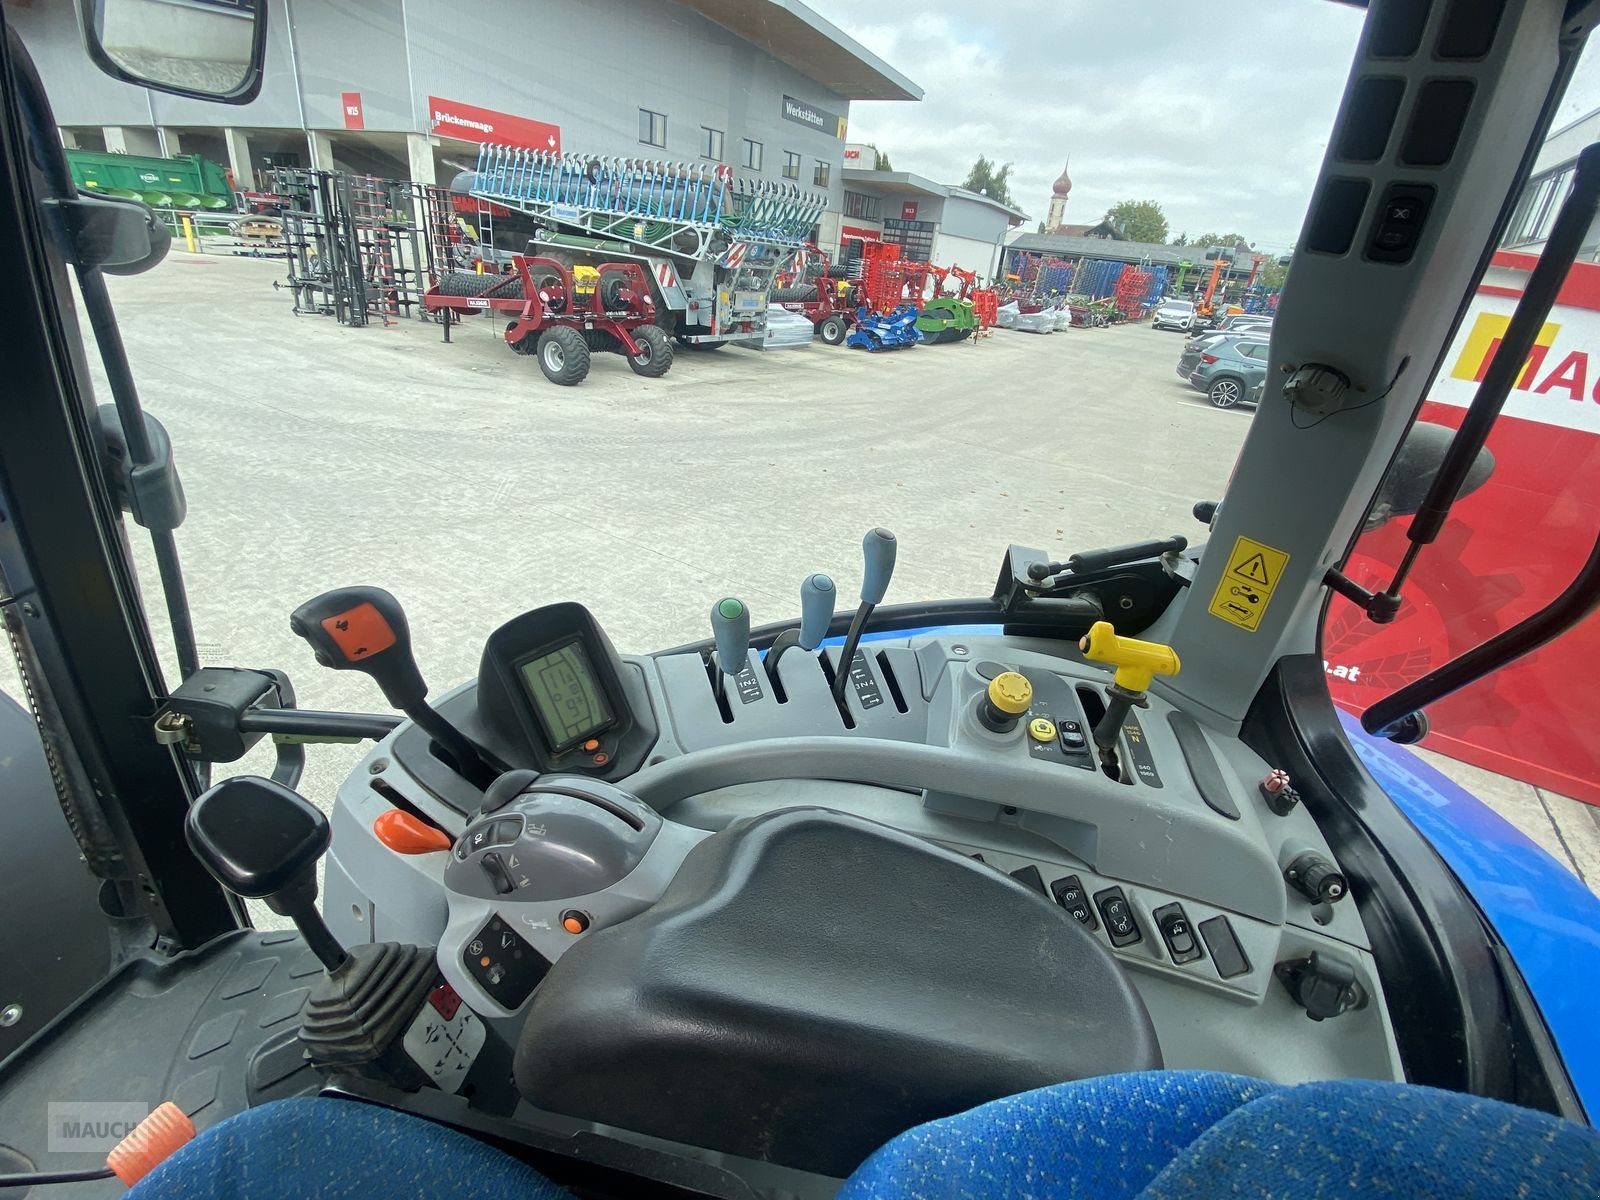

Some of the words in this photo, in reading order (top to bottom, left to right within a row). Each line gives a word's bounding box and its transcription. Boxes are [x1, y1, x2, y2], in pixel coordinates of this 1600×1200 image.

[435, 111, 493, 133] Brückenwaage
[786, 102, 824, 127] Werkstätten
[1473, 337, 1600, 405] MA
[1131, 735, 1140, 743] N
